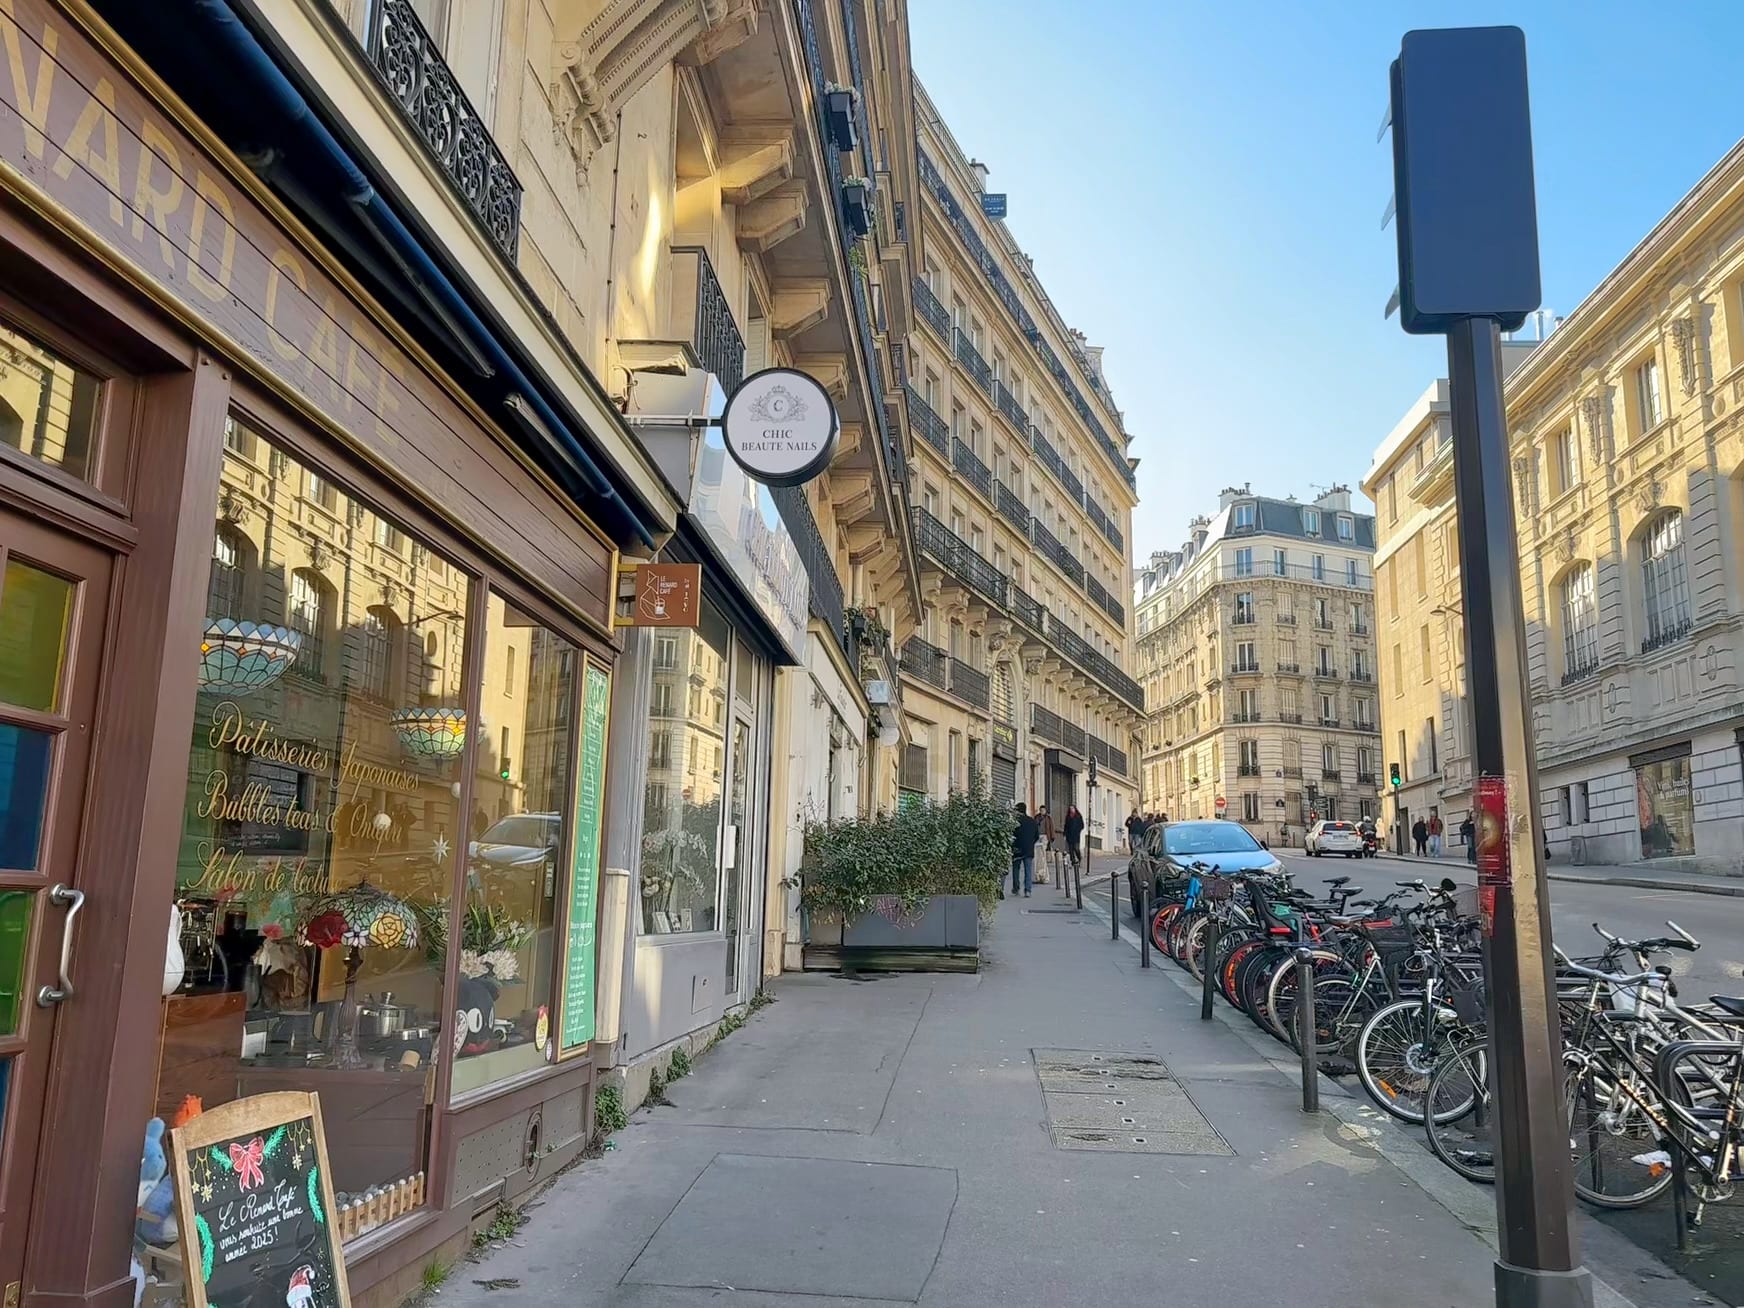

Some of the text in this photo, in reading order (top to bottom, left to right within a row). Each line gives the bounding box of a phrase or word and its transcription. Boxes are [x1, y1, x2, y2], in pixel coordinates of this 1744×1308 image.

[773, 400, 784, 412] C
[741, 442, 817, 451] BEAUTE NAILS
[762, 430, 793, 439] CHIC
[330, 740, 420, 803] Japonaises
[197, 769, 281, 826] Bubbles
[286, 795, 321, 832] teas
[186, 842, 256, 892] Salon
[263, 855, 287, 892] de
[218, 1201, 237, 1232] Le
[239, 1193, 276, 1222] Renard
[219, 1235, 238, 1249] vous
[267, 1214, 281, 1227] une
[282, 1206, 304, 1220] bonne
[225, 1242, 248, 1263] année
